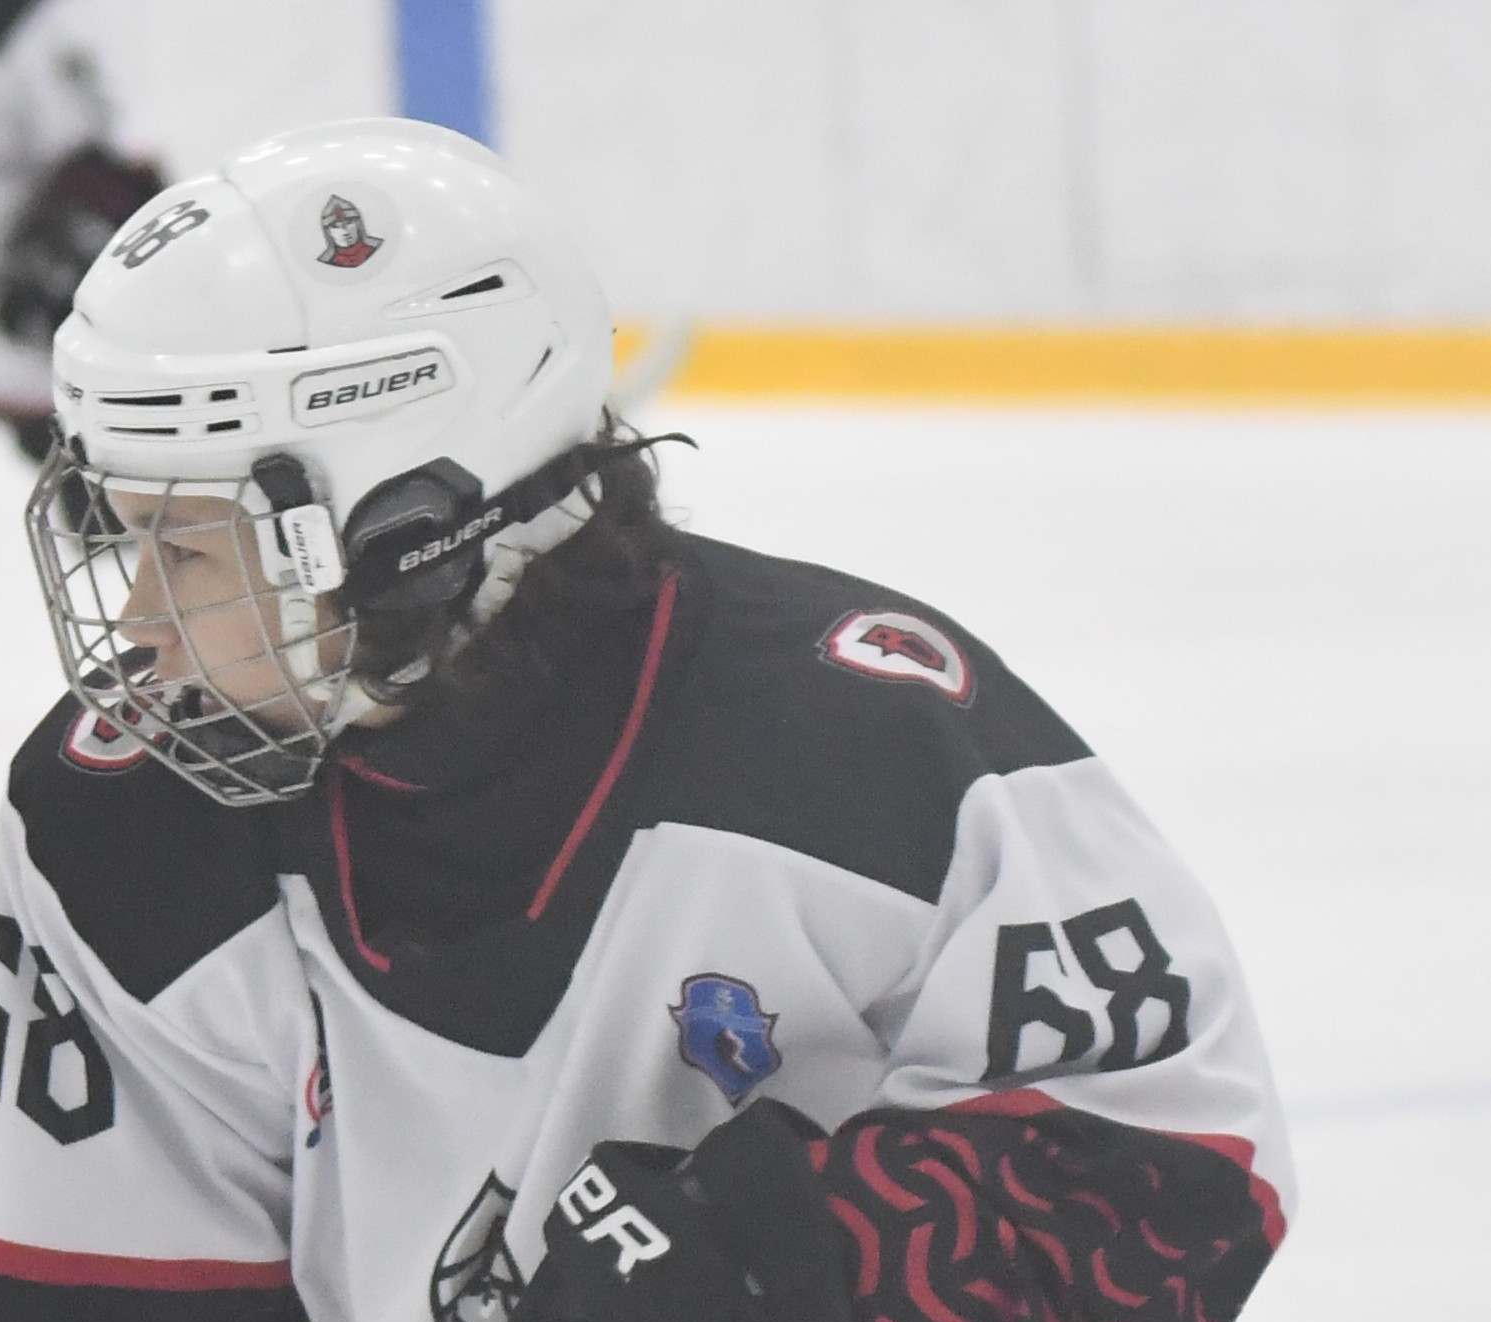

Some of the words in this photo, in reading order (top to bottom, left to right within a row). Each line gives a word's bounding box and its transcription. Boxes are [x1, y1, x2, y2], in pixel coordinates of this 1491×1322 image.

[307, 362, 439, 412] BAUER
[398, 505, 504, 573] BAUER
[981, 896, 1192, 1083] 68
